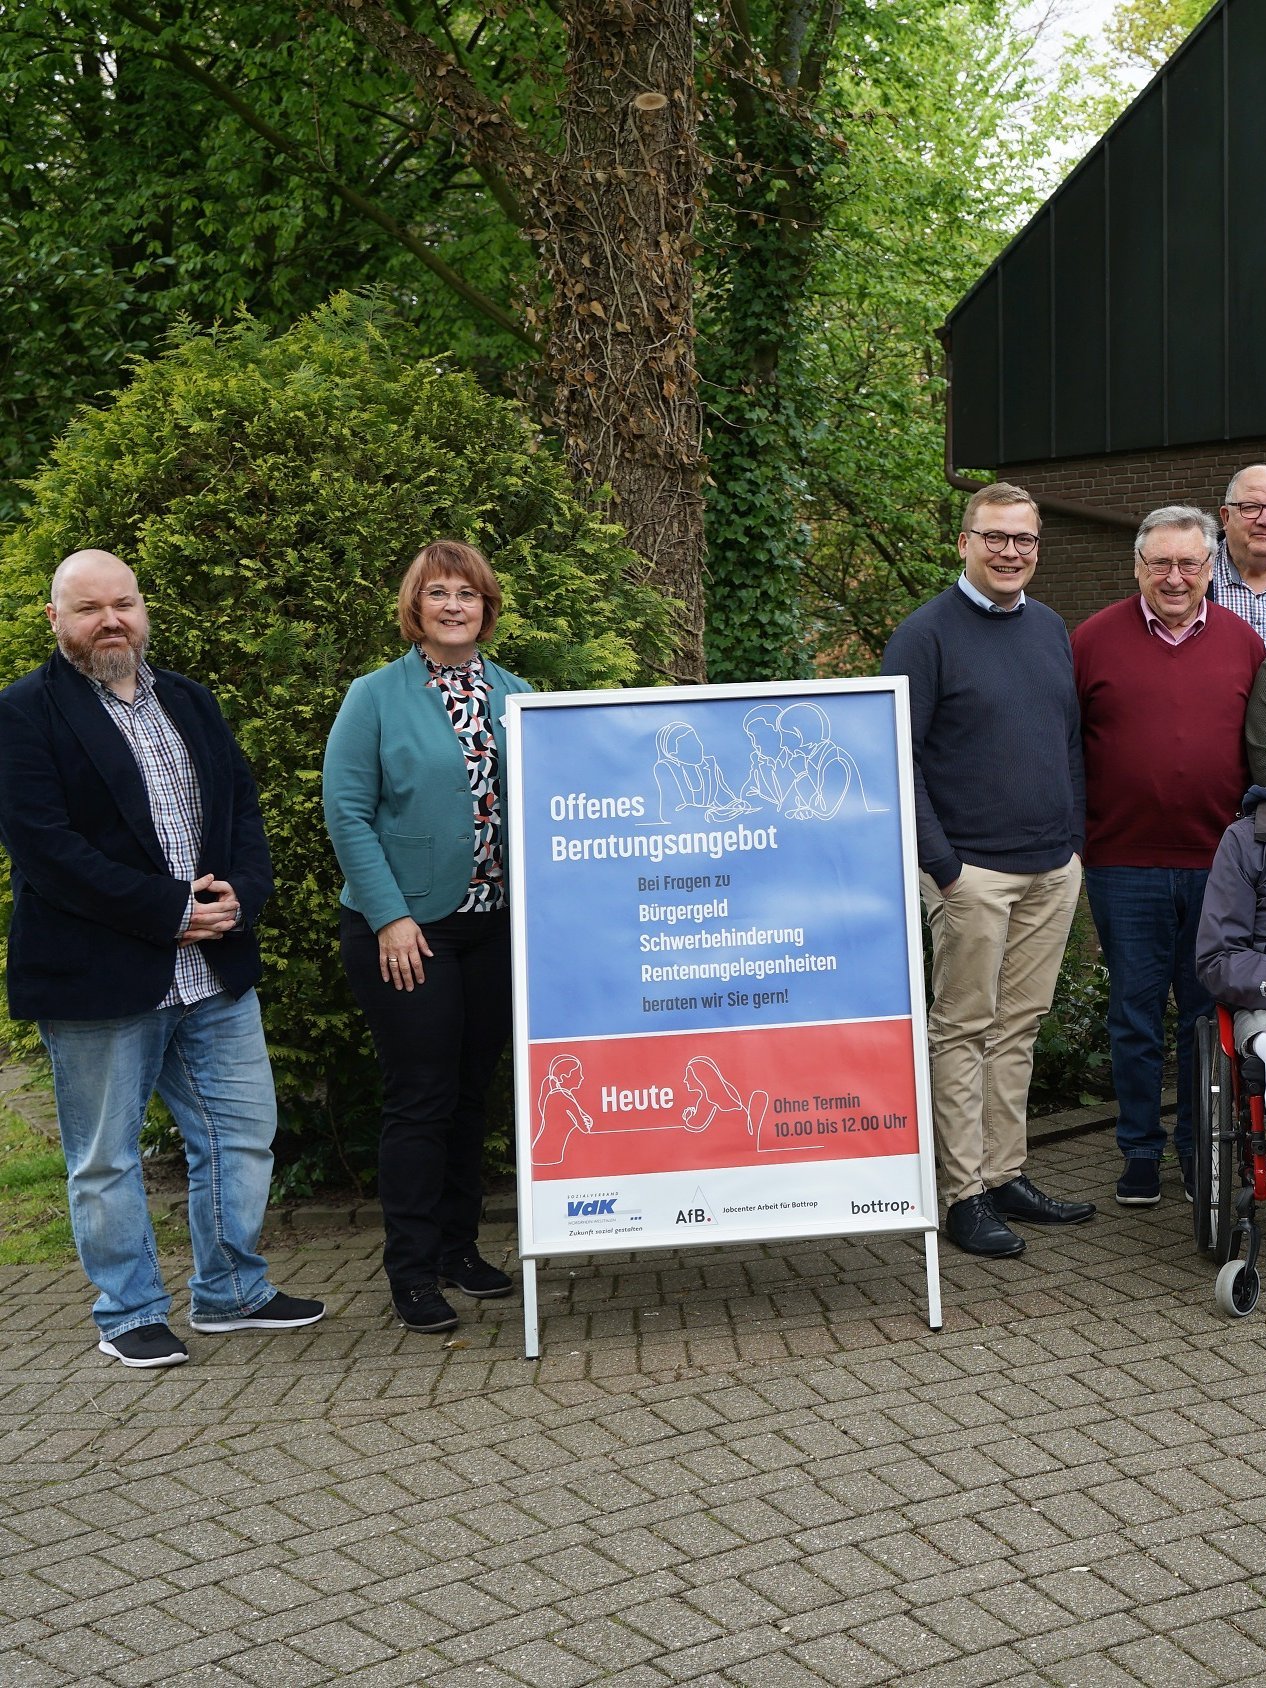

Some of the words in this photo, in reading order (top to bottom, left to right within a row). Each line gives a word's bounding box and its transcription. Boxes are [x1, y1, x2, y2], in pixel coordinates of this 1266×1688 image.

[550, 794, 645, 822] Offenes
[551, 824, 778, 863] Beratungsangebot
[638, 875, 660, 892] Bei
[664, 874, 711, 893] Fragen
[715, 874, 731, 888] zu
[639, 898, 728, 925] Bürgergeld
[640, 927, 804, 952] Schwerbehinderung
[641, 953, 837, 983] Rentenangelegenheiten
[643, 995, 698, 1013] beraten
[701, 992, 724, 1009] wir
[728, 991, 749, 1007] Sie
[753, 988, 789, 1009] gern!
[601, 1084, 674, 1113] Heute
[773, 1098, 809, 1114] Ohne
[813, 1092, 861, 1111] Termin
[775, 1120, 813, 1138] 10.00
[817, 1118, 838, 1135] bis
[841, 1116, 879, 1133] 12.00
[883, 1113, 908, 1130] Uhr
[567, 1191, 619, 1199] SOZIALVERBAND
[567, 1199, 618, 1217] VdK
[675, 1208, 712, 1225] AfB.
[722, 1205, 756, 1214] Jobcenter
[757, 1203, 779, 1211] Arbeit
[780, 1201, 791, 1209] für
[791, 1200, 818, 1209] Bottrop
[851, 1199, 916, 1215] bottrop.
[569, 1229, 594, 1237] Zukunft
[595, 1227, 614, 1235] sozial
[615, 1226, 643, 1235] gestalten
